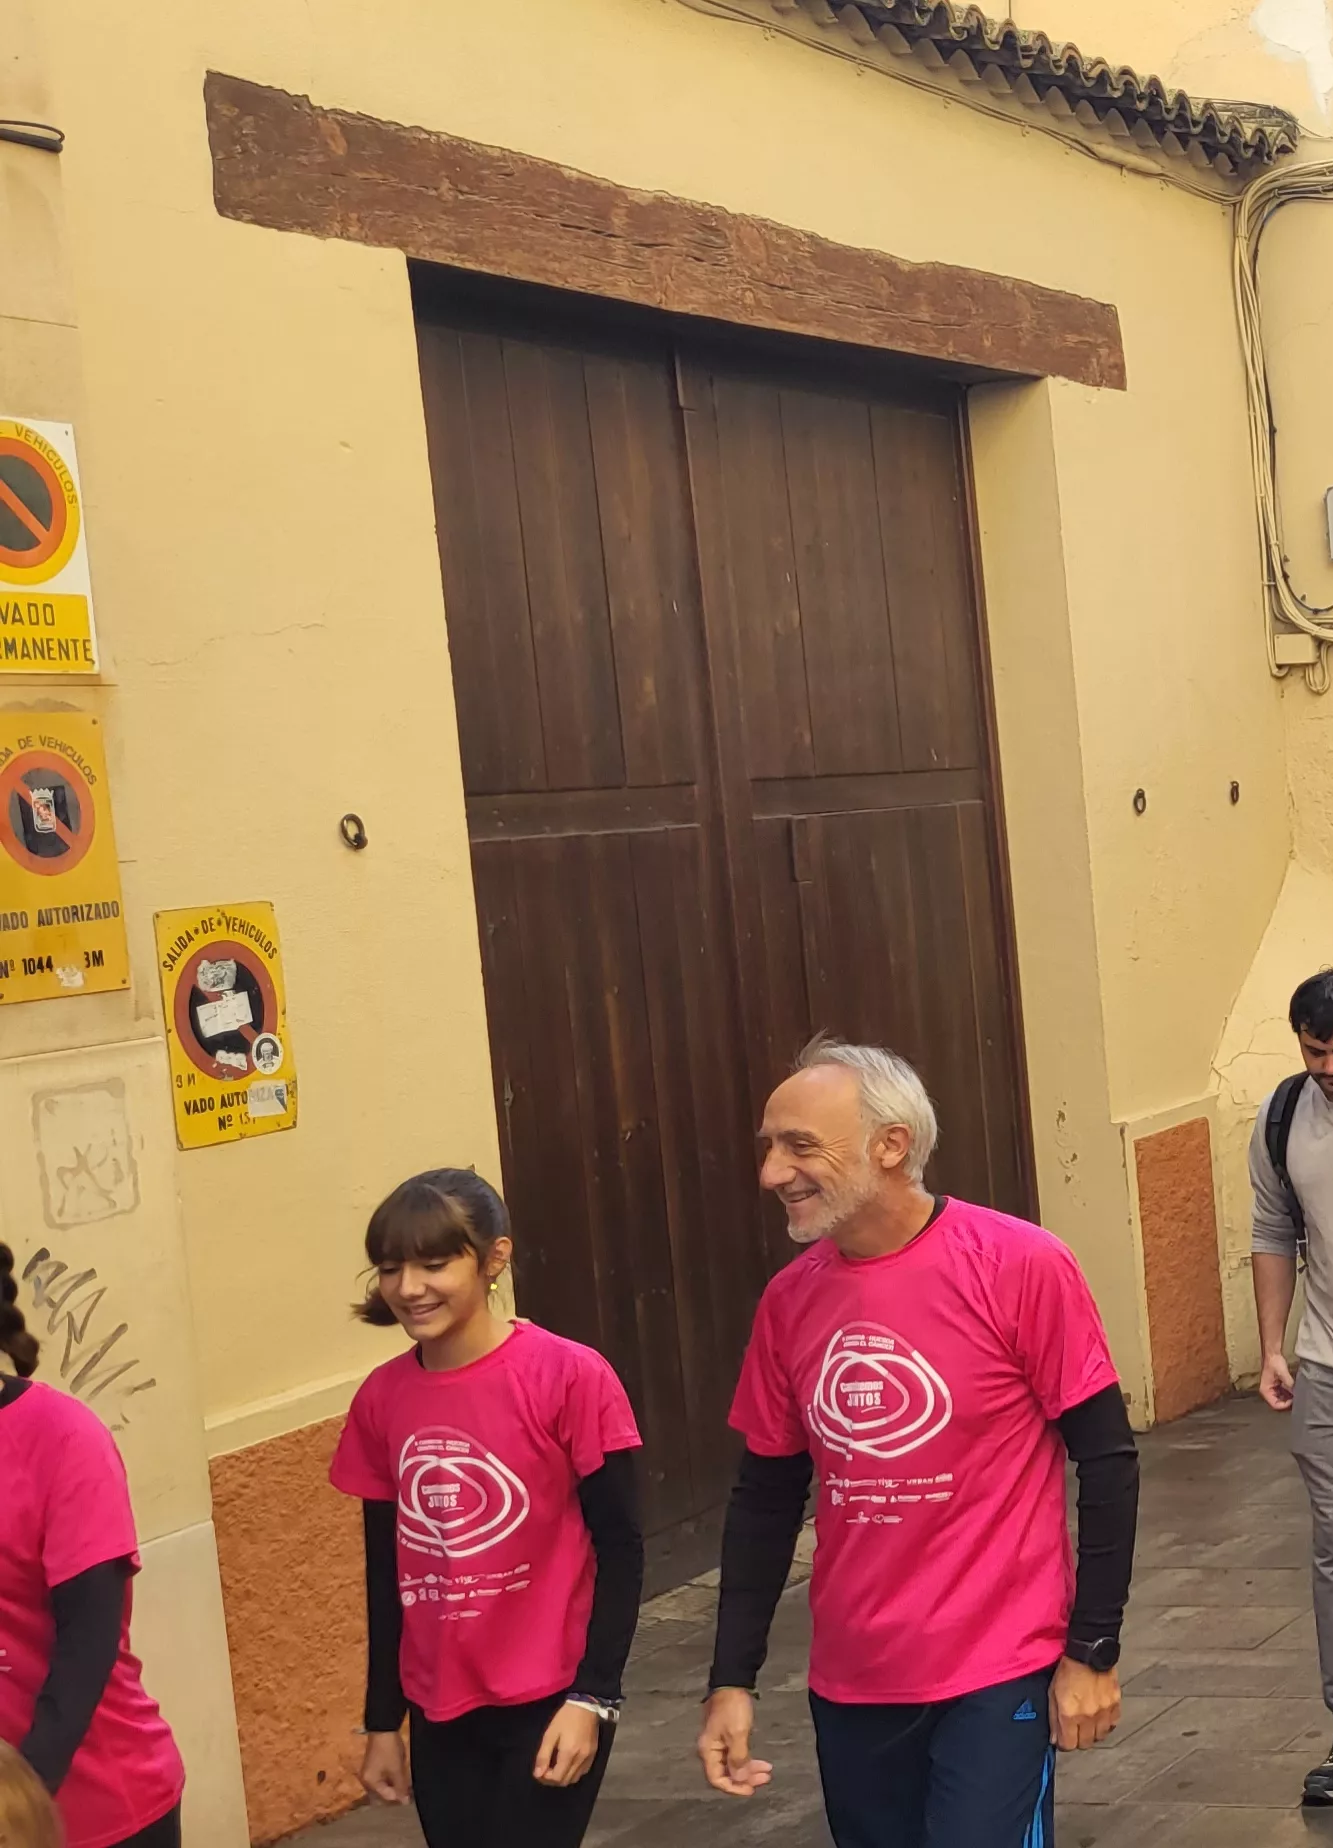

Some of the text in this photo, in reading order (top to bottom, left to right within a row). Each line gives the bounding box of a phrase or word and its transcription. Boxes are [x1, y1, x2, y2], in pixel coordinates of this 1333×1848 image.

[14, 423, 78, 505] VEHICULOS
[17, 736, 34, 751] DE
[38, 735, 97, 786] VEHICULOS
[0, 900, 120, 931] ADO AUTORIZADO
[162, 915, 278, 972] SALIDA DE VEHICULOS
[22, 955, 54, 976] 1044
[184, 1096, 216, 1116] VADO
